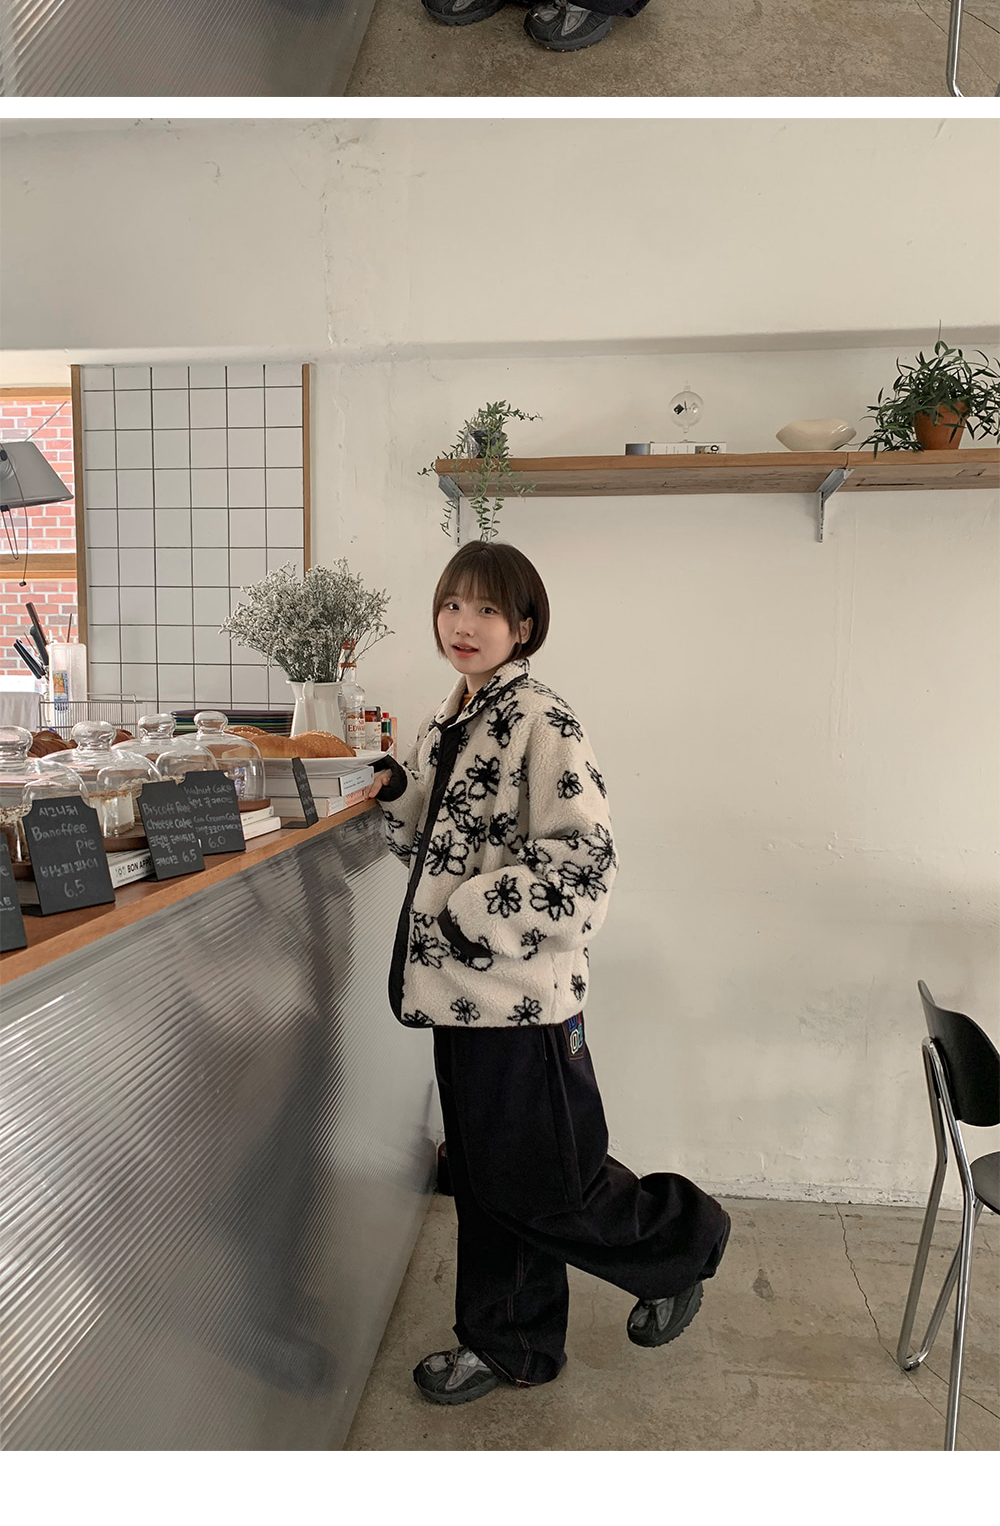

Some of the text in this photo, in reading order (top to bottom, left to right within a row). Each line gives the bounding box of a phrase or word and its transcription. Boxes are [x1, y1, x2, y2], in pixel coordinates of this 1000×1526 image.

[142, 803, 174, 816] Biscoff
[146, 818, 193, 830] Cheese Cake
[31, 823, 88, 841] Banoffee
[76, 837, 97, 856] pie
[208, 835, 226, 848] 6.0
[182, 849, 197, 863] 6.5
[127, 861, 139, 873] BON
[64, 878, 85, 898] 6.5
